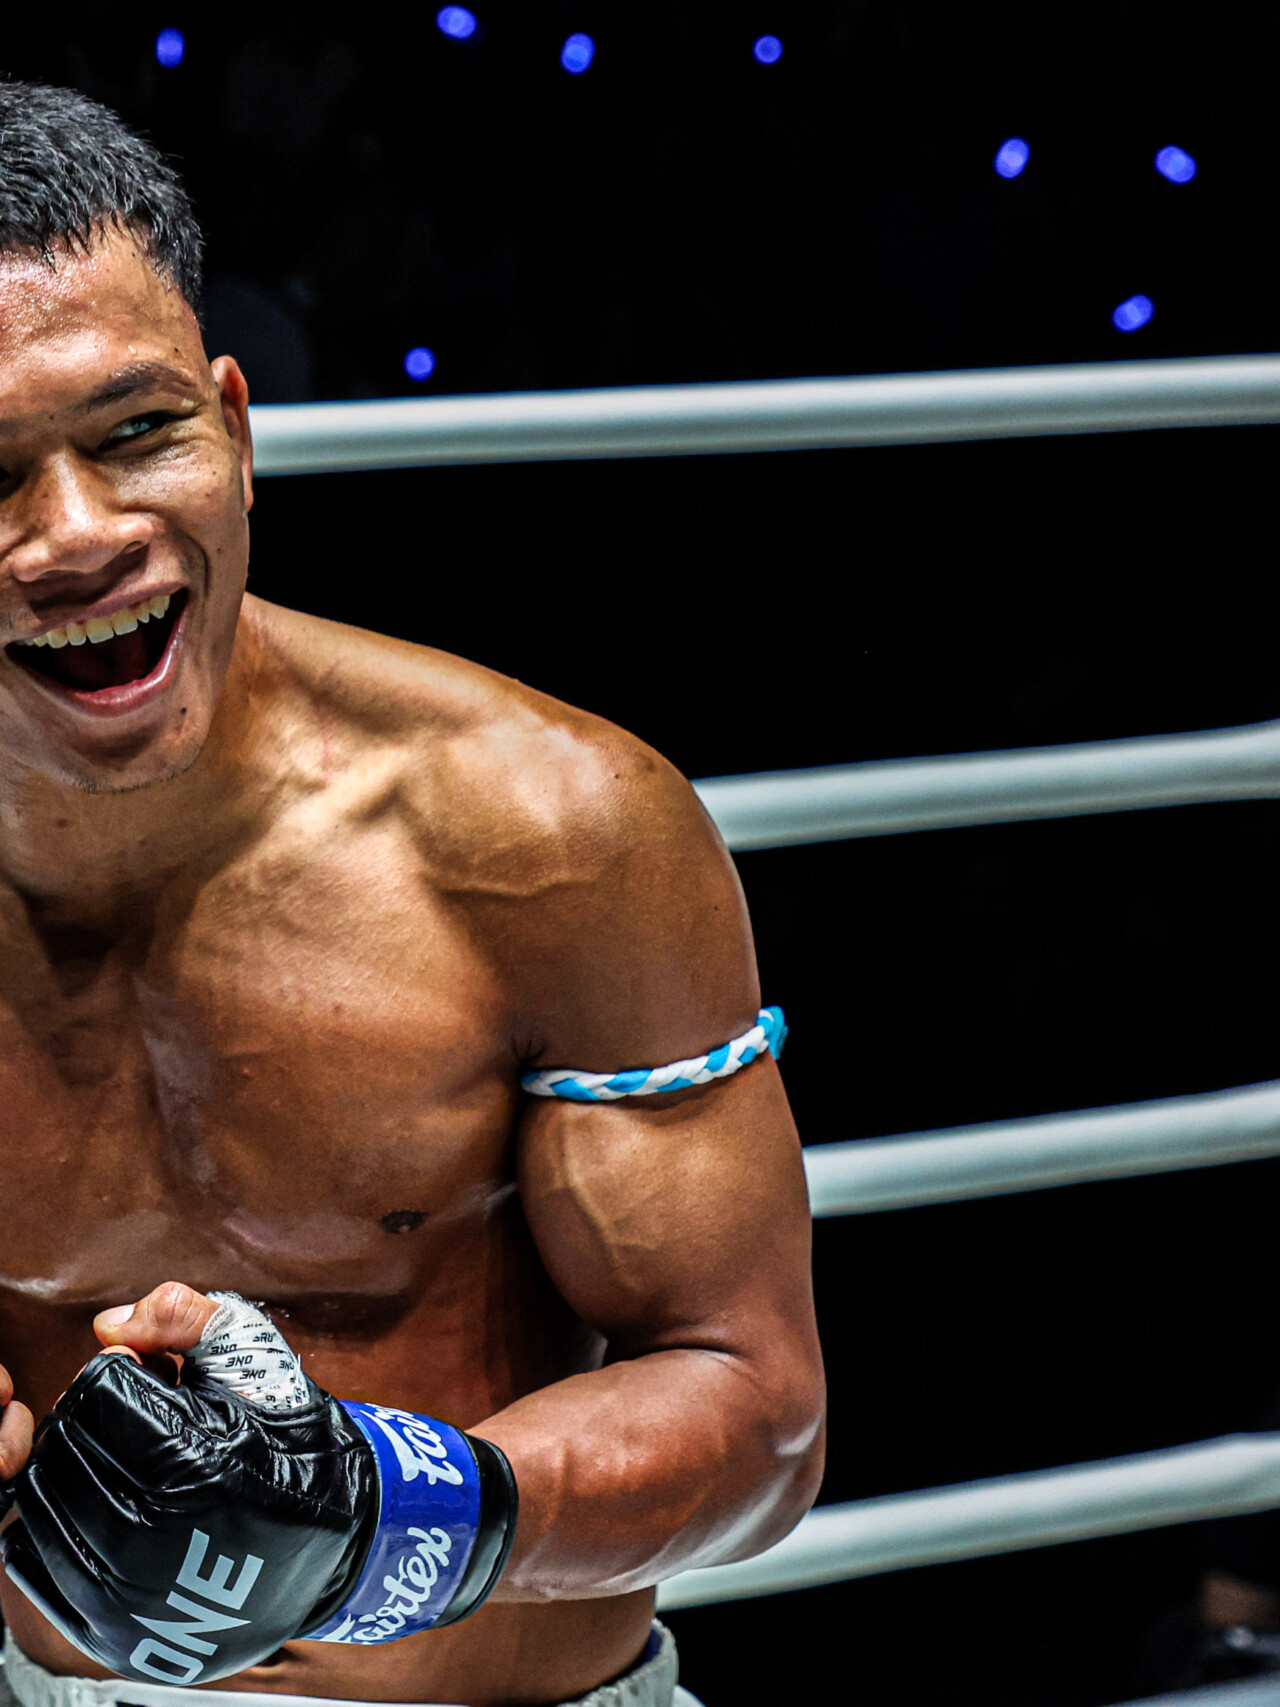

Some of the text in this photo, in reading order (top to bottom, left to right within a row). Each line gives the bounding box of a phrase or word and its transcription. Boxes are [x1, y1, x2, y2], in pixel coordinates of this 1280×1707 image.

[225, 1355, 253, 1368] ONE
[239, 1369, 267, 1380] ONE
[129, 1528, 265, 1685] ONE
